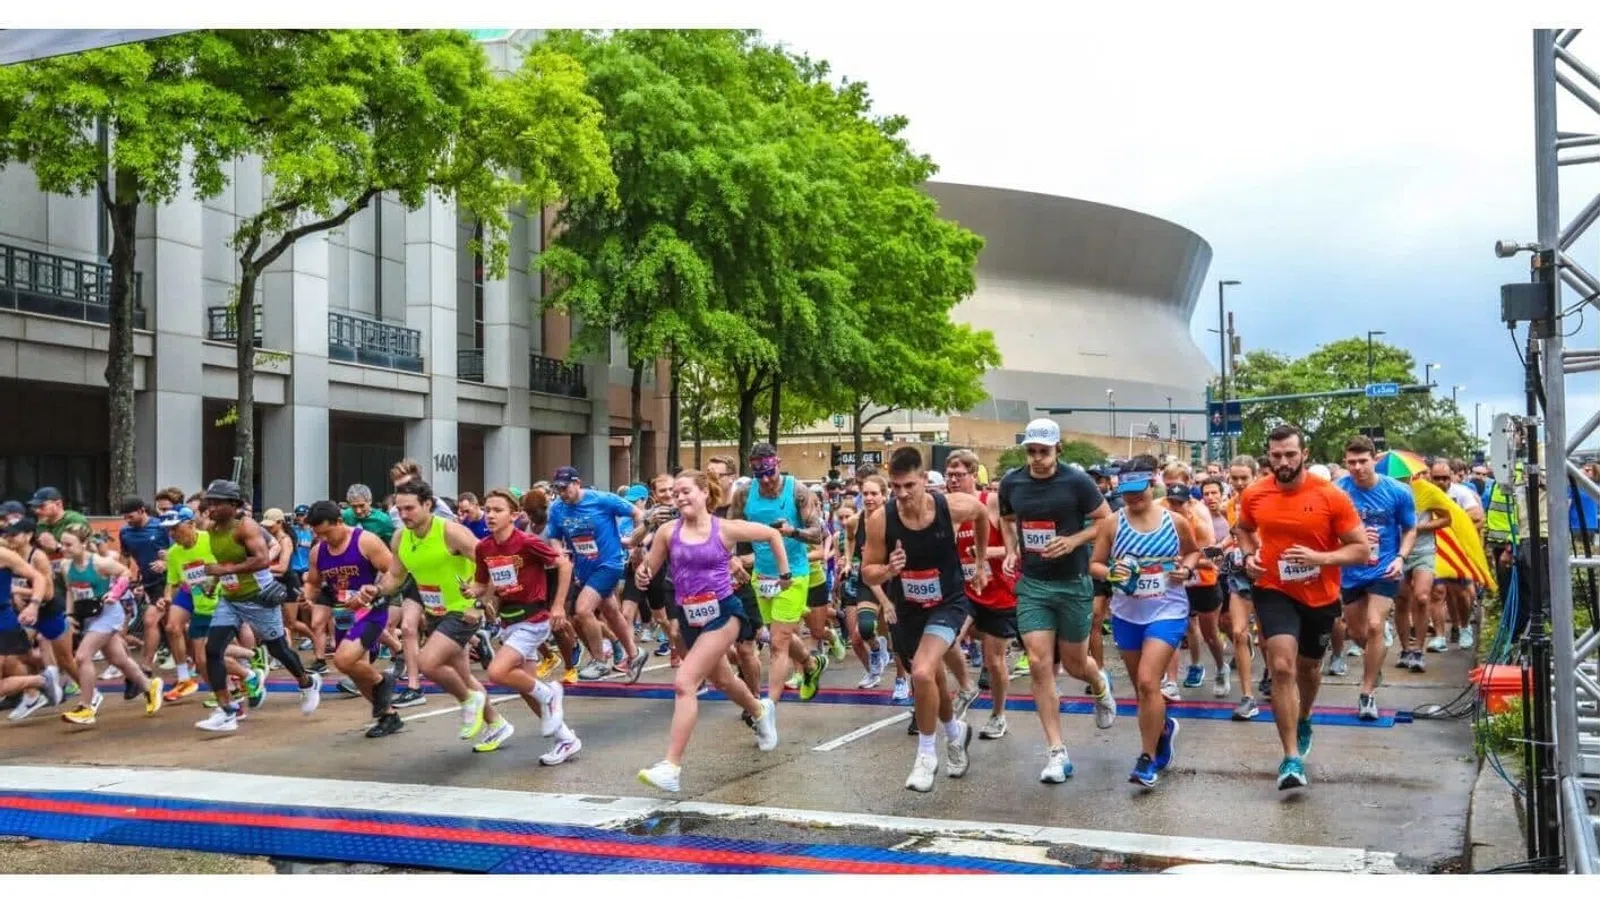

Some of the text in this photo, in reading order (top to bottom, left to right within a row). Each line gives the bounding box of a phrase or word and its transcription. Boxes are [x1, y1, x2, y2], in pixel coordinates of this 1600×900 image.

[433, 454, 457, 472] 1400
[842, 453, 873, 463] GAGE
[906, 582, 936, 595] 2896
[1138, 578, 1160, 590] 575
[688, 604, 716, 619] 2499
